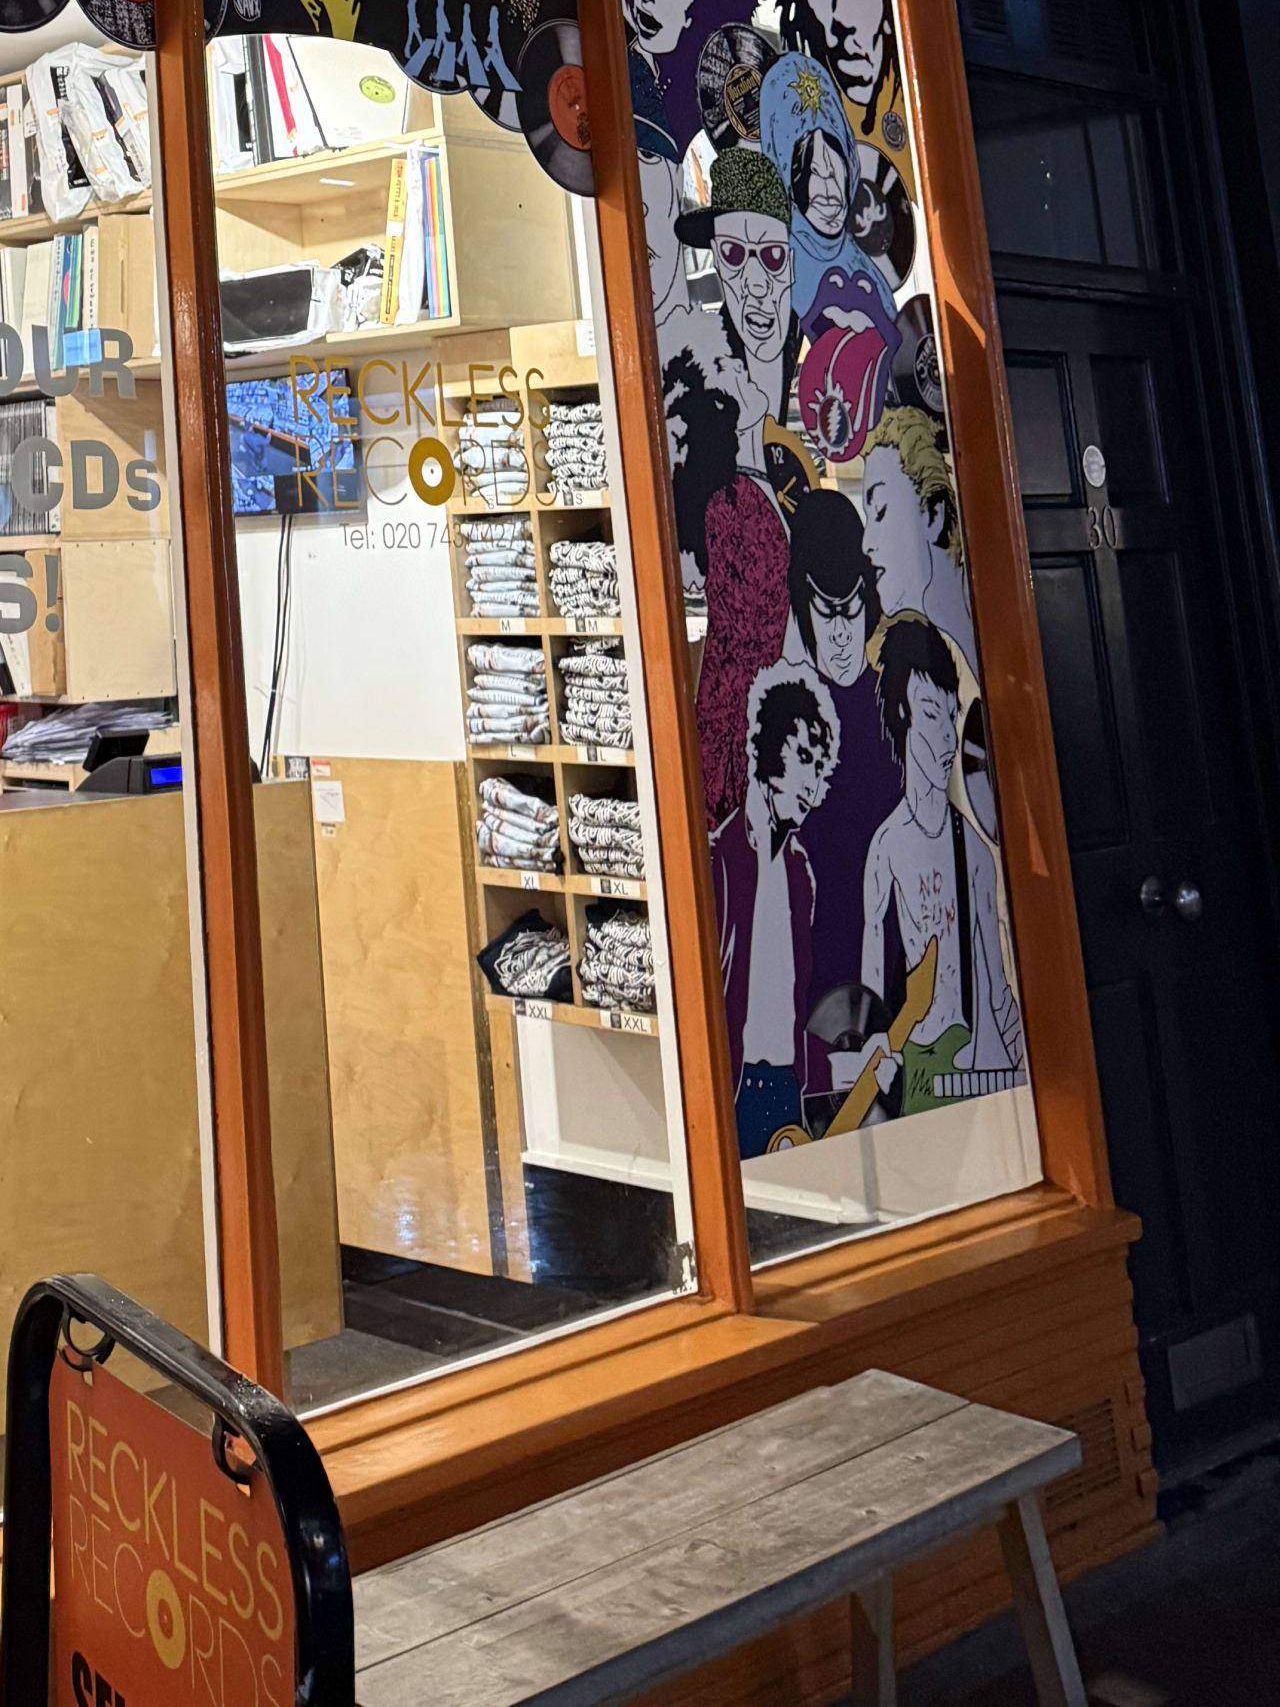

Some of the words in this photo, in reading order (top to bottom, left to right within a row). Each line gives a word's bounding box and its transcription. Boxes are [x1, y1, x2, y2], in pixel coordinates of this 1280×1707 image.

[288, 354, 551, 430] RECKLESS
[771, 446, 784, 465] 12
[11, 436, 162, 512] CDs
[293, 435, 558, 509] RECORDS
[339, 521, 376, 550] Tel:
[382, 522, 421, 549] 020
[501, 620, 511, 632] M
[588, 619, 598, 632] M
[600, 750, 607, 761] L
[613, 881, 629, 895] XL
[528, 1004, 552, 1020] XXL
[624, 1016, 647, 1032] XXL
[66, 1399, 284, 1642] RECKLESS
